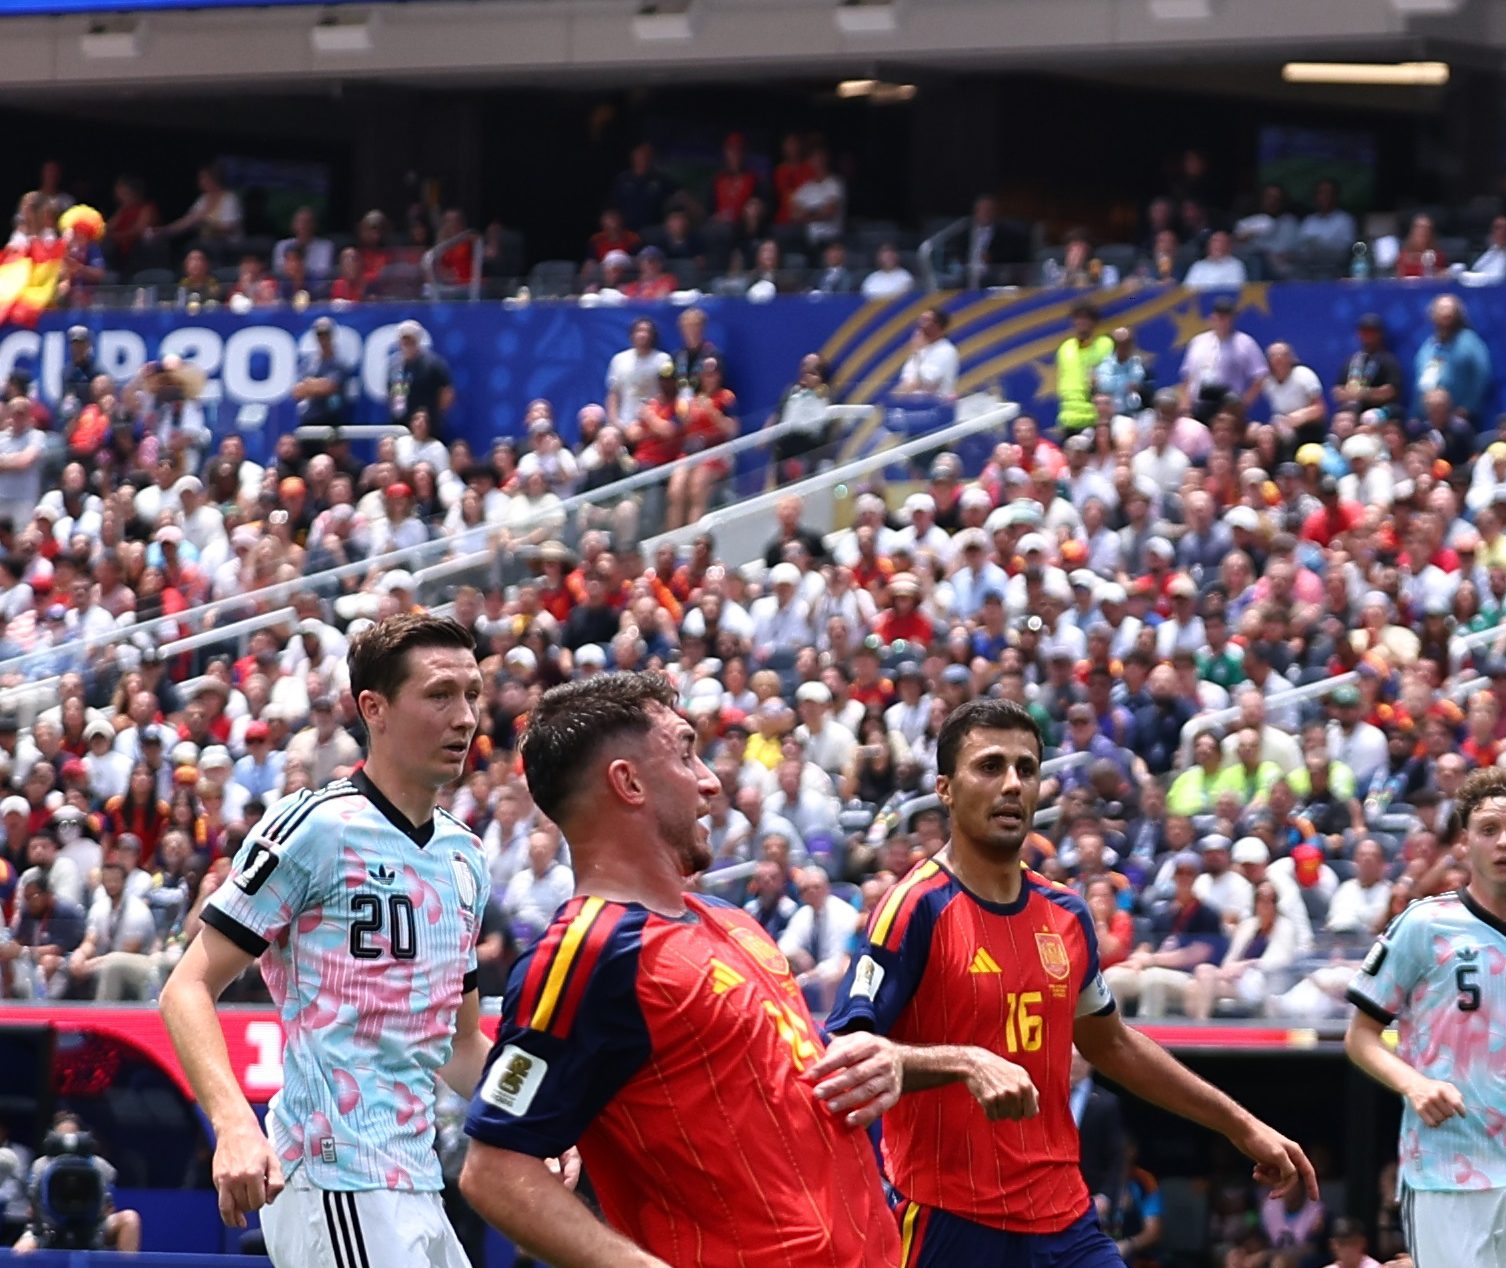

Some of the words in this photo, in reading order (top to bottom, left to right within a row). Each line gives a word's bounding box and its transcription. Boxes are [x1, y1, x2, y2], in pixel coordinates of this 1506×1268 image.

[350, 893, 416, 960] 20
[1455, 964, 1481, 1011] 5
[1006, 991, 1043, 1053] 16
